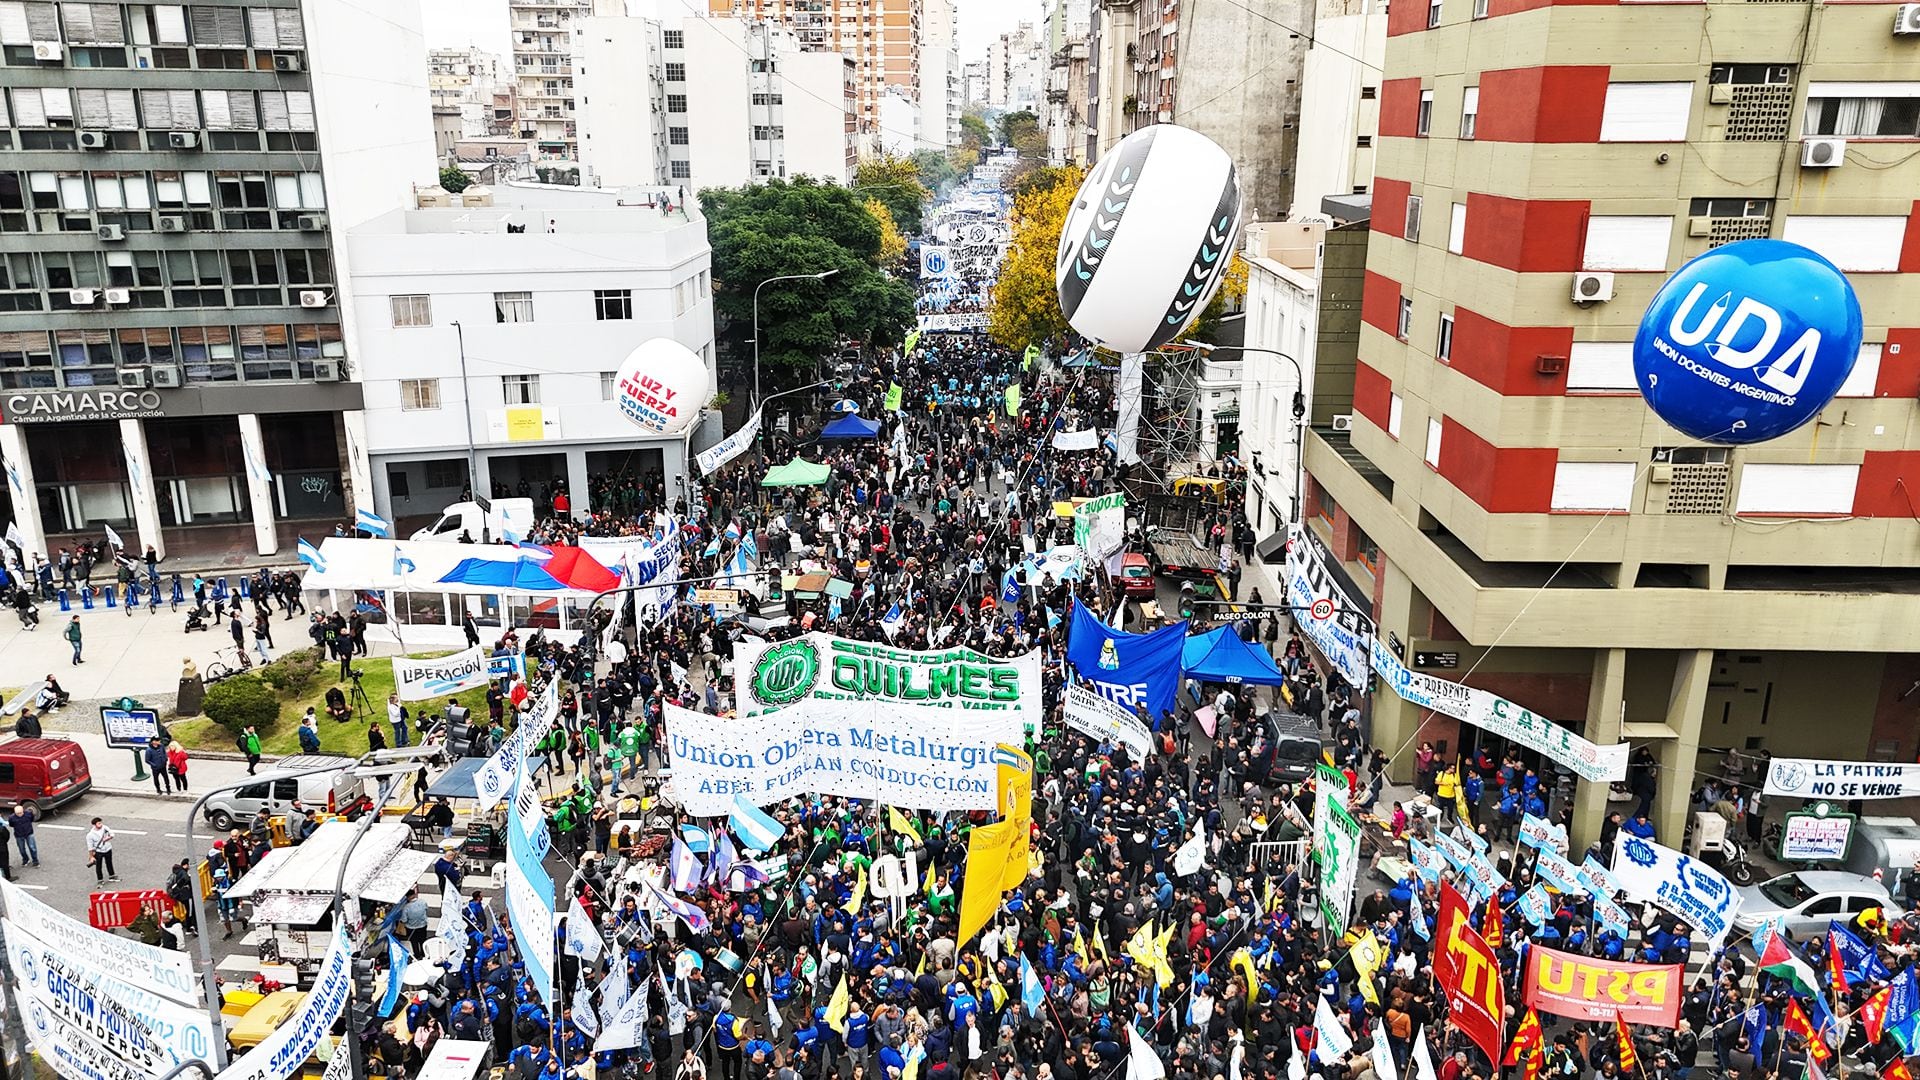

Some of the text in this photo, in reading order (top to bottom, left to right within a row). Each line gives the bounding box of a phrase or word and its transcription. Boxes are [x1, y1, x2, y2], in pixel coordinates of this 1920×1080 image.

[1669, 281, 1821, 396] UDA
[632, 370, 677, 401] LUZ Y
[1653, 336, 1797, 406] UNION DOCENTES ARGENTINOS
[8, 391, 161, 415] CAMARCO
[12, 410, 165, 423] Cámara Argentina de la Construcción
[619, 378, 677, 418] FUERZA
[620, 394, 667, 425] SOMOS
[1316, 605, 1329, 614] 60
[831, 655, 1020, 702] QUILMES
[1225, 676, 1242, 684] UTEP
[1812, 782, 1902, 796] NO SE VENDE
[1815, 764, 1835, 776] LA
[1843, 765, 1902, 777] PATRIA
[41, 951, 65, 975] FELIZ
[83, 979, 98, 999] DEL
[47, 969, 94, 1019] GASTON
[324, 975, 349, 1028] DIGNIDAD
[54, 998, 153, 1067] PANADEROS
[270, 1006, 316, 1073] SINDICATO
[312, 992, 326, 1015] DEL
